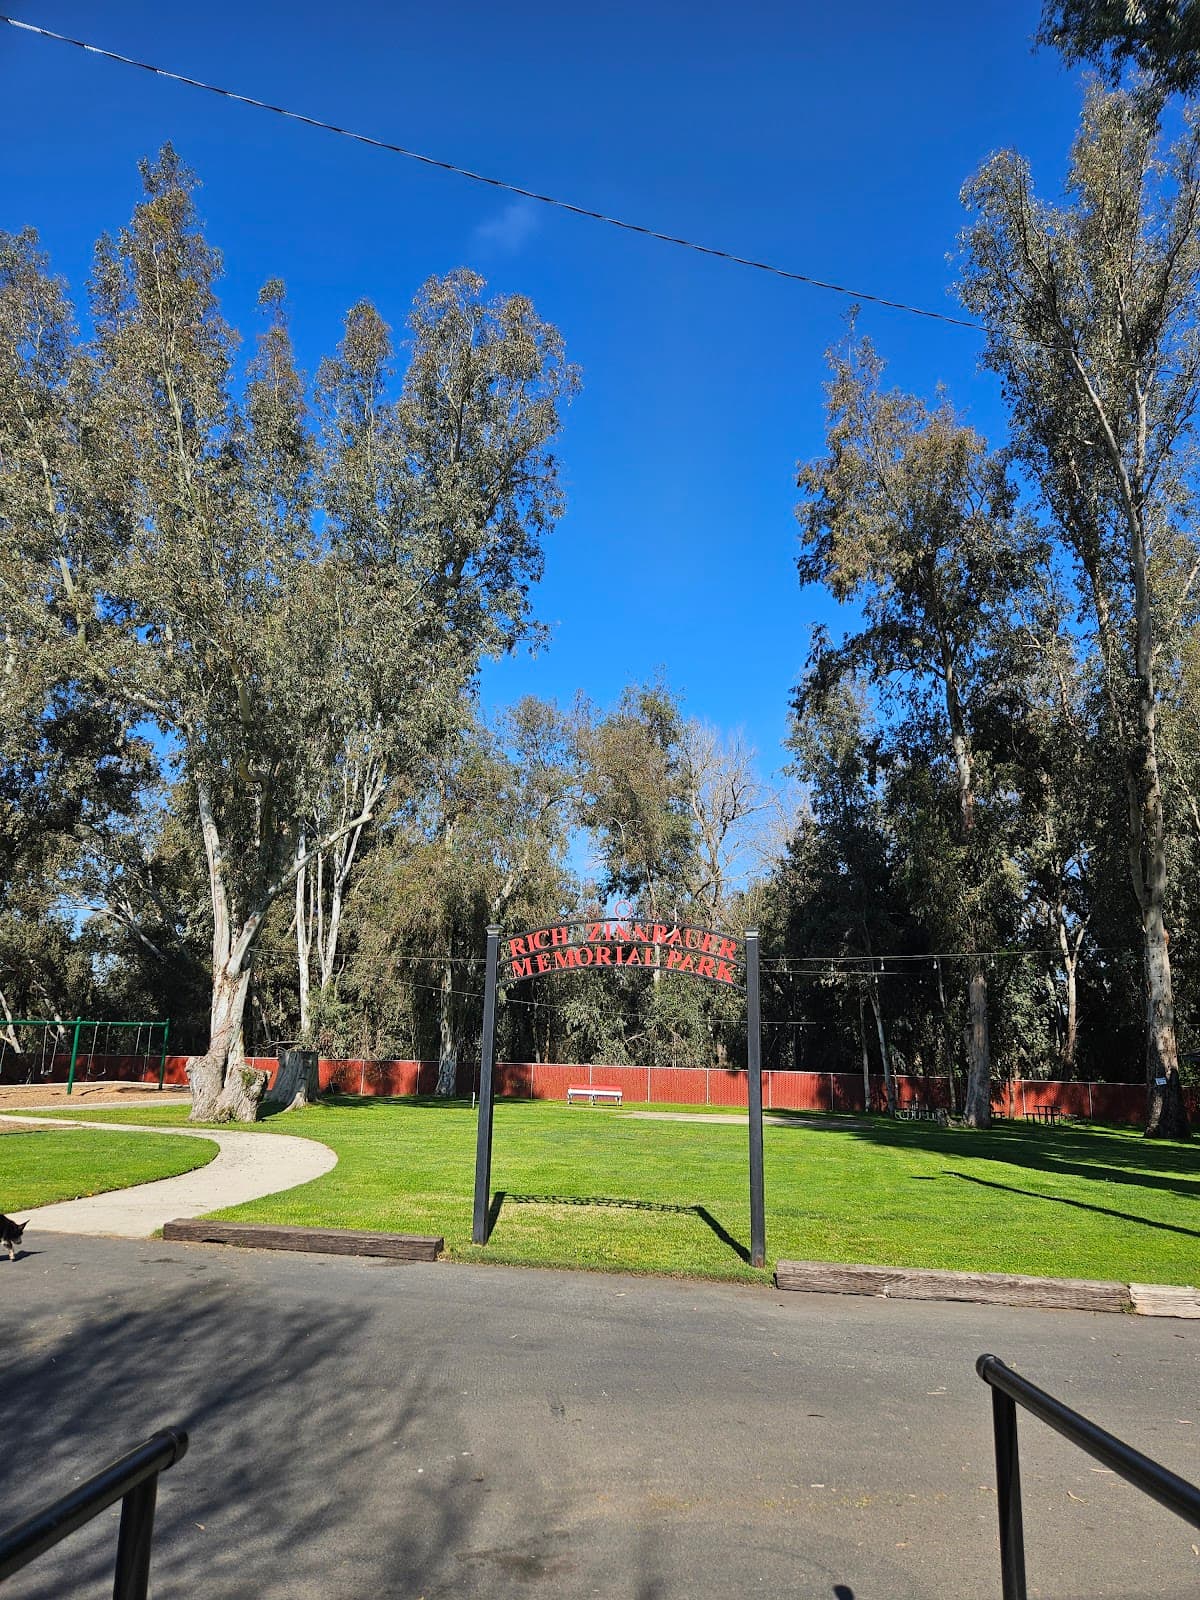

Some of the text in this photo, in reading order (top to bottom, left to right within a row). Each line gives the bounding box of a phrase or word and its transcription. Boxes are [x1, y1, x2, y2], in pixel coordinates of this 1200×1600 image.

[508, 922, 738, 961] RICH ZINNBAUER
[511, 947, 737, 984] MEMORIAL PARK
